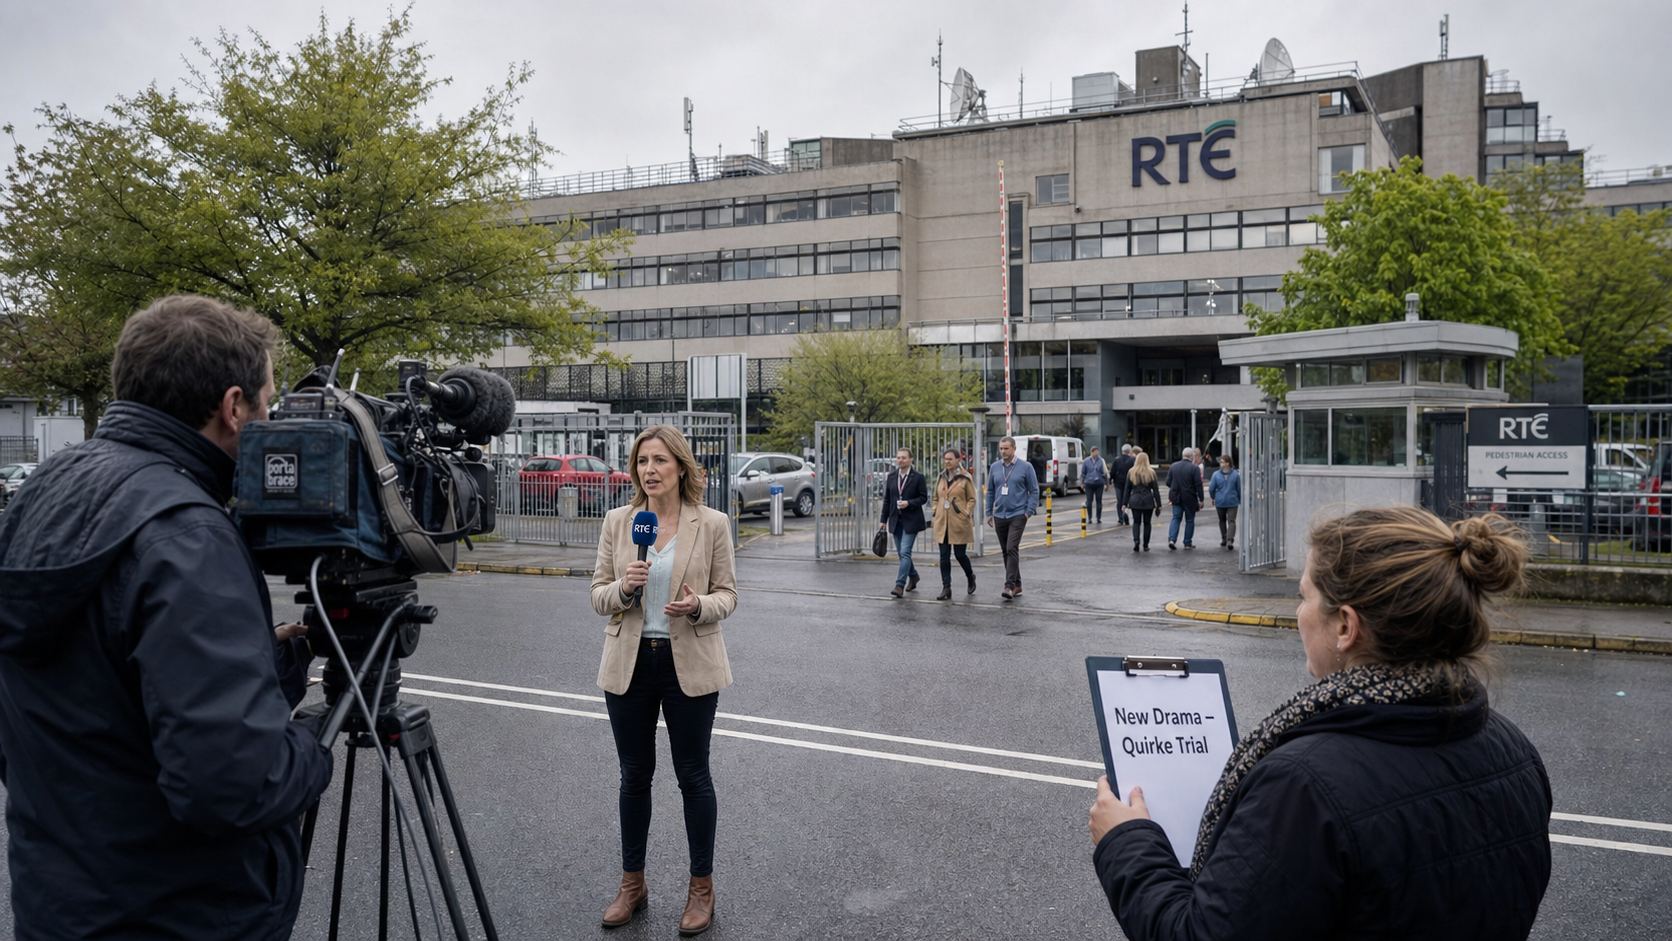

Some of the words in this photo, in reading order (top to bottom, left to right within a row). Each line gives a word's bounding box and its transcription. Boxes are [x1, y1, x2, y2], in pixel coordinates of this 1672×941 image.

[1131, 119, 1236, 187] RTÉ
[1499, 412, 1549, 440] RTÉ
[1485, 451, 1534, 459] PEDESTRIAN
[1536, 451, 1568, 459] ACCESS
[268, 459, 295, 475] porta
[267, 475, 295, 486] brace
[1114, 707, 1149, 725] New
[1152, 707, 1202, 725] Drama
[1122, 736, 1173, 758] Quirke
[1175, 735, 1209, 754] Trial
